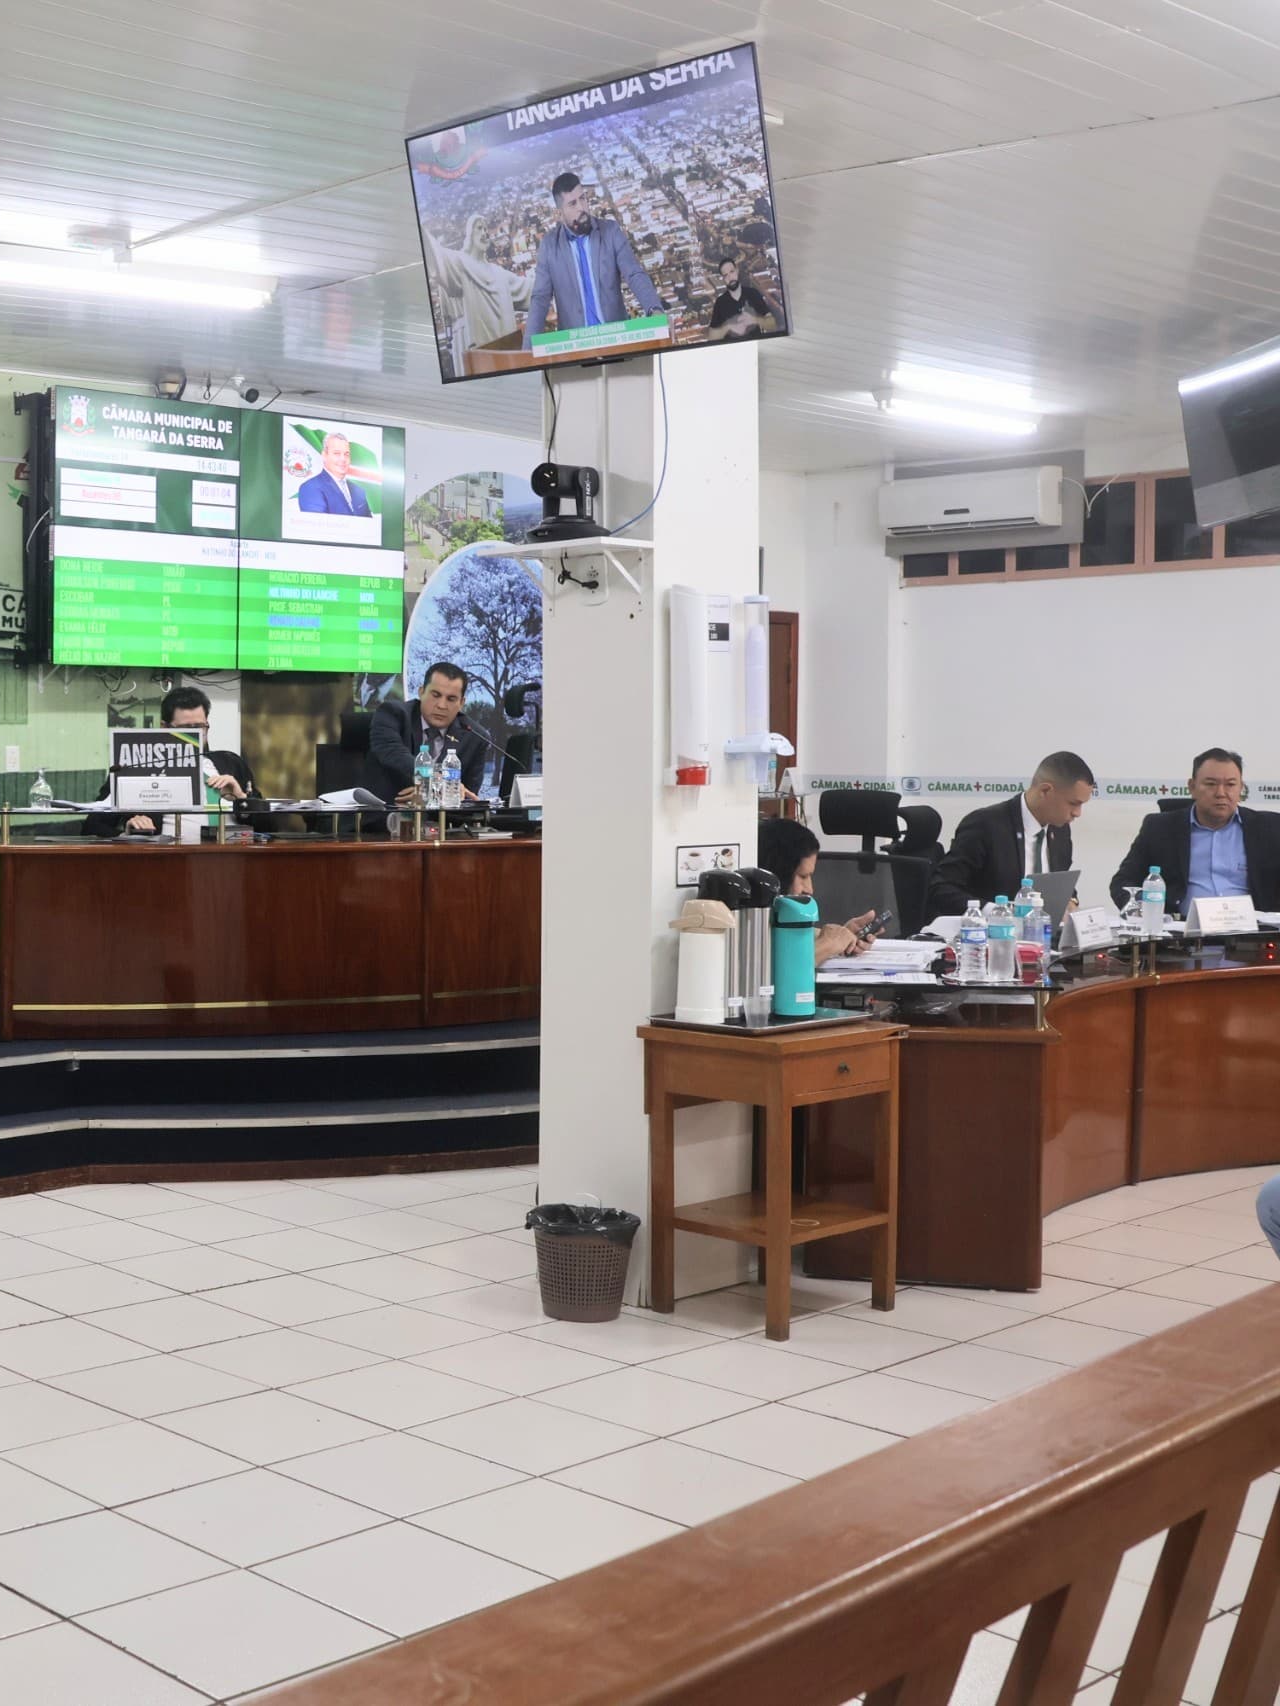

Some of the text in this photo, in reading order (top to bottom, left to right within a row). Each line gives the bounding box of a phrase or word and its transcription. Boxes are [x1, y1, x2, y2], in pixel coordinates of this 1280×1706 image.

[610, 73, 645, 102] DA
[649, 51, 736, 91] SERRA
[102, 403, 233, 434] CÂMARA MUNICIPAL DE
[112, 425, 224, 451] TANGARÁ DA SERRA
[119, 743, 196, 768] ANISTIA
